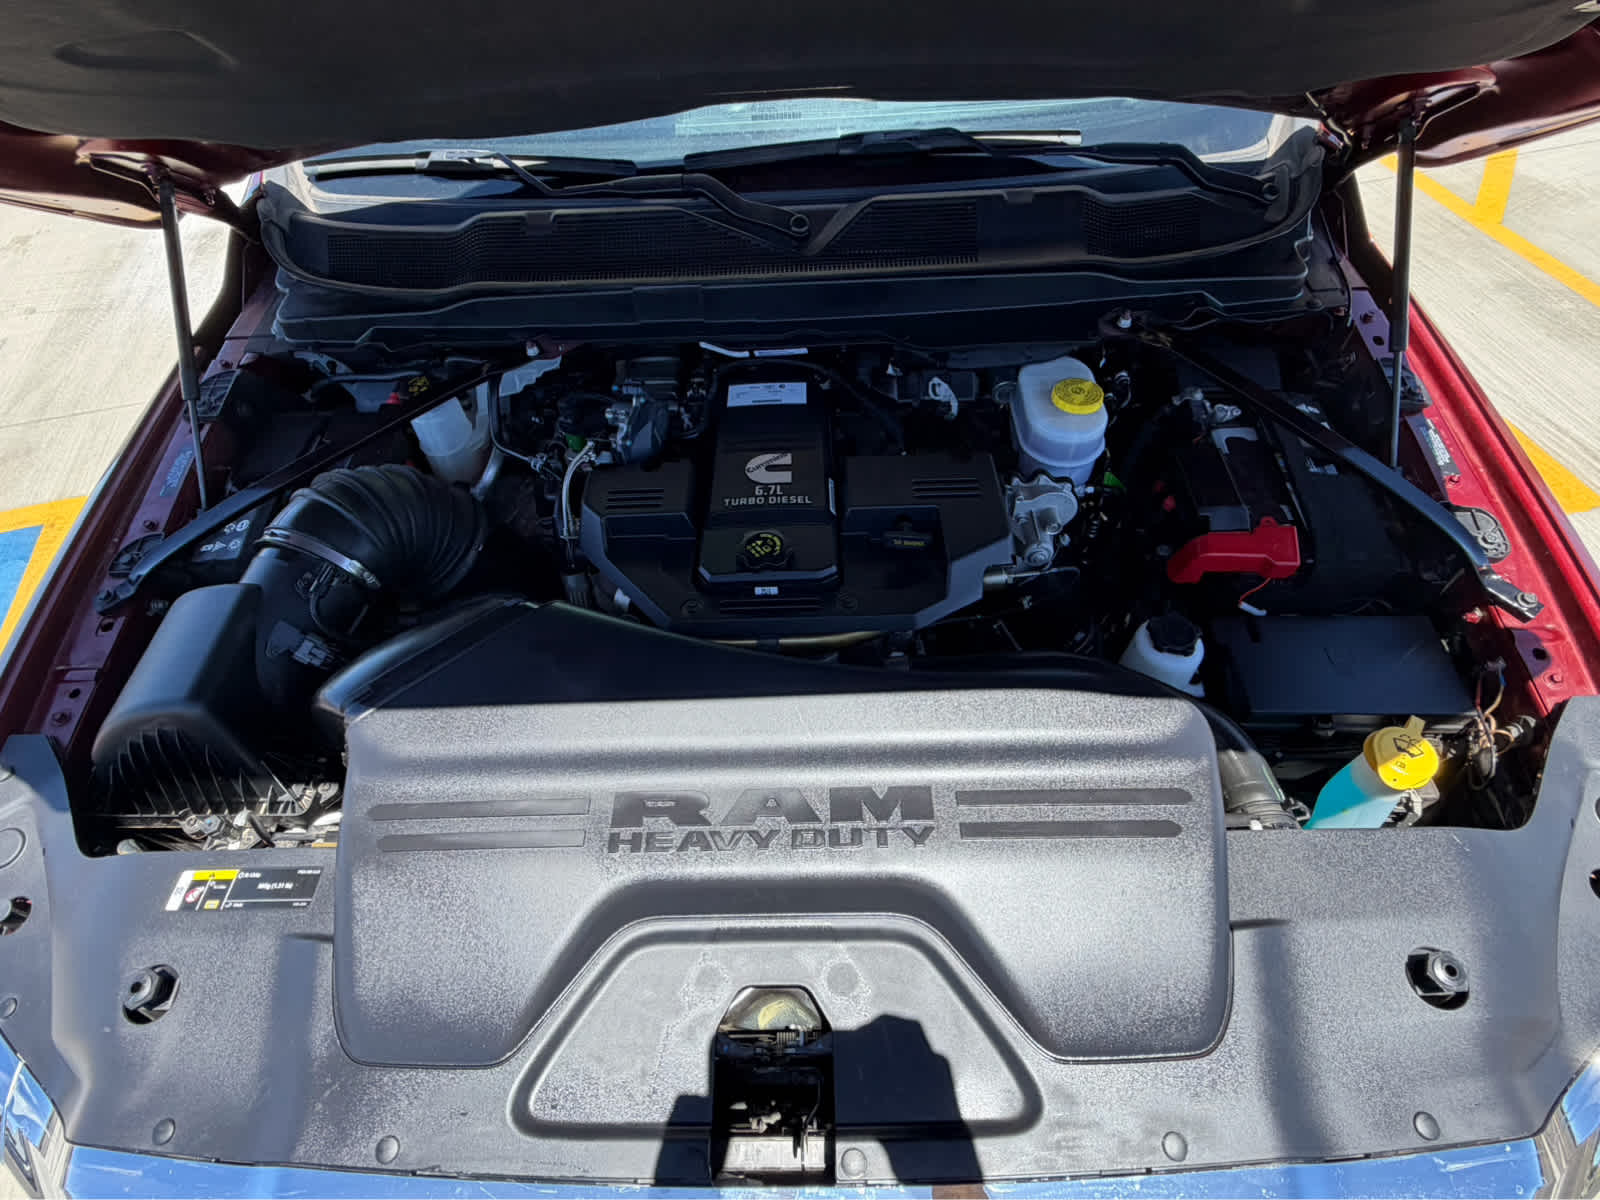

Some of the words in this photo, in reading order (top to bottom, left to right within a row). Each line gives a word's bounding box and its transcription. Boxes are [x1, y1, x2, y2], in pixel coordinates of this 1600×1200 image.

[754, 485, 783, 496] 6.7L
[723, 496, 765, 506] TURBO
[768, 495, 813, 504] DIESEL
[611, 787, 935, 828] RAM
[608, 829, 783, 853] HEAVY
[792, 826, 936, 850] DUTY
